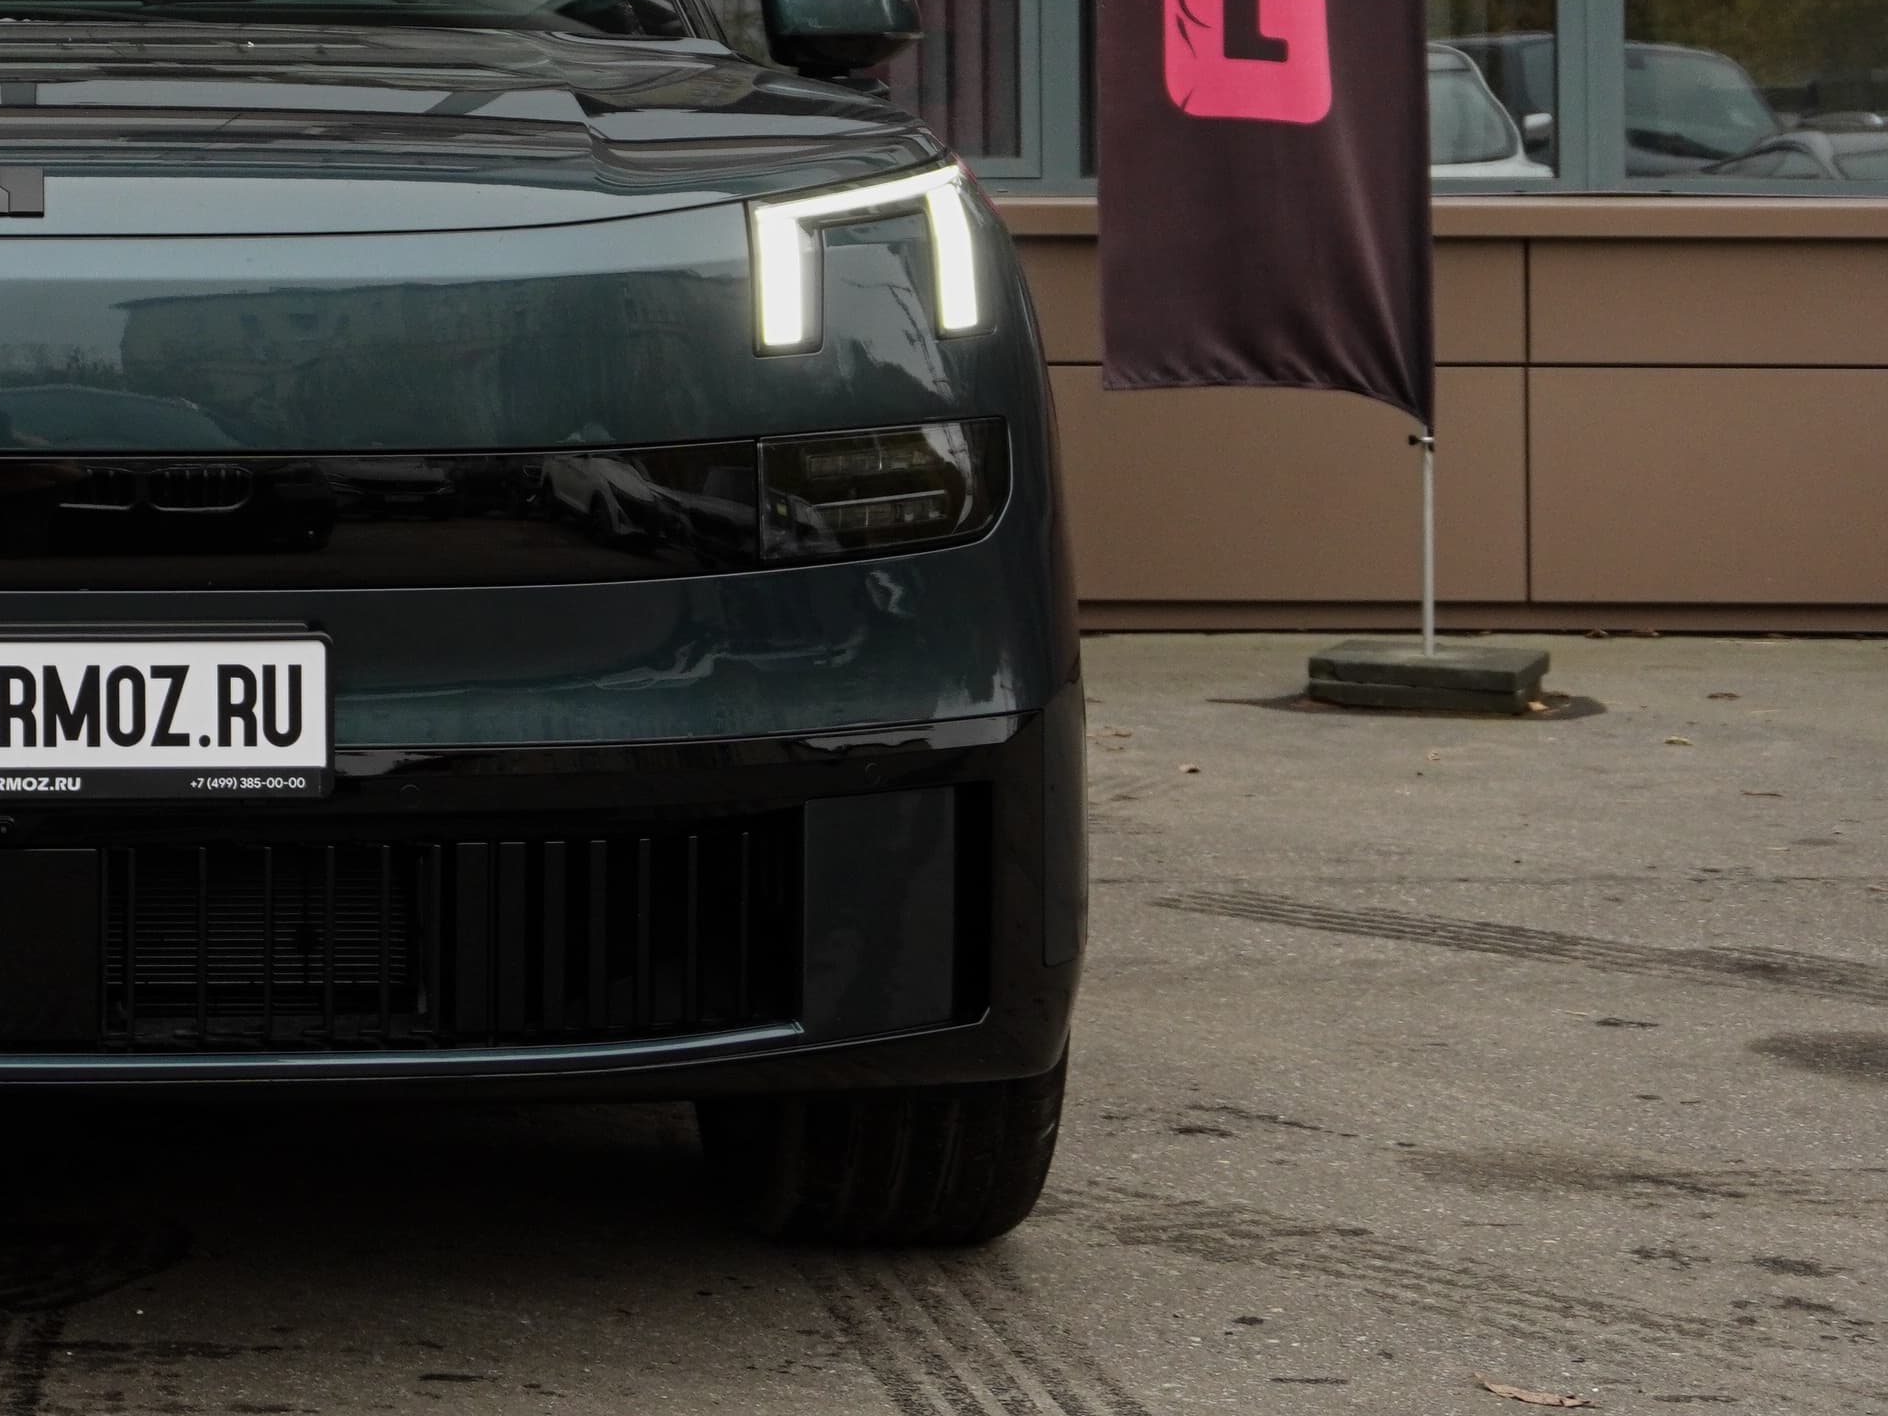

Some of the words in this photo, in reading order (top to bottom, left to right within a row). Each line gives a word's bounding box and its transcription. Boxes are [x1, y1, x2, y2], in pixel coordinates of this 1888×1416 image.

[190, 777, 205, 789] +7
[207, 776, 237, 790] (499)
[239, 777, 306, 789] 385-00-00
